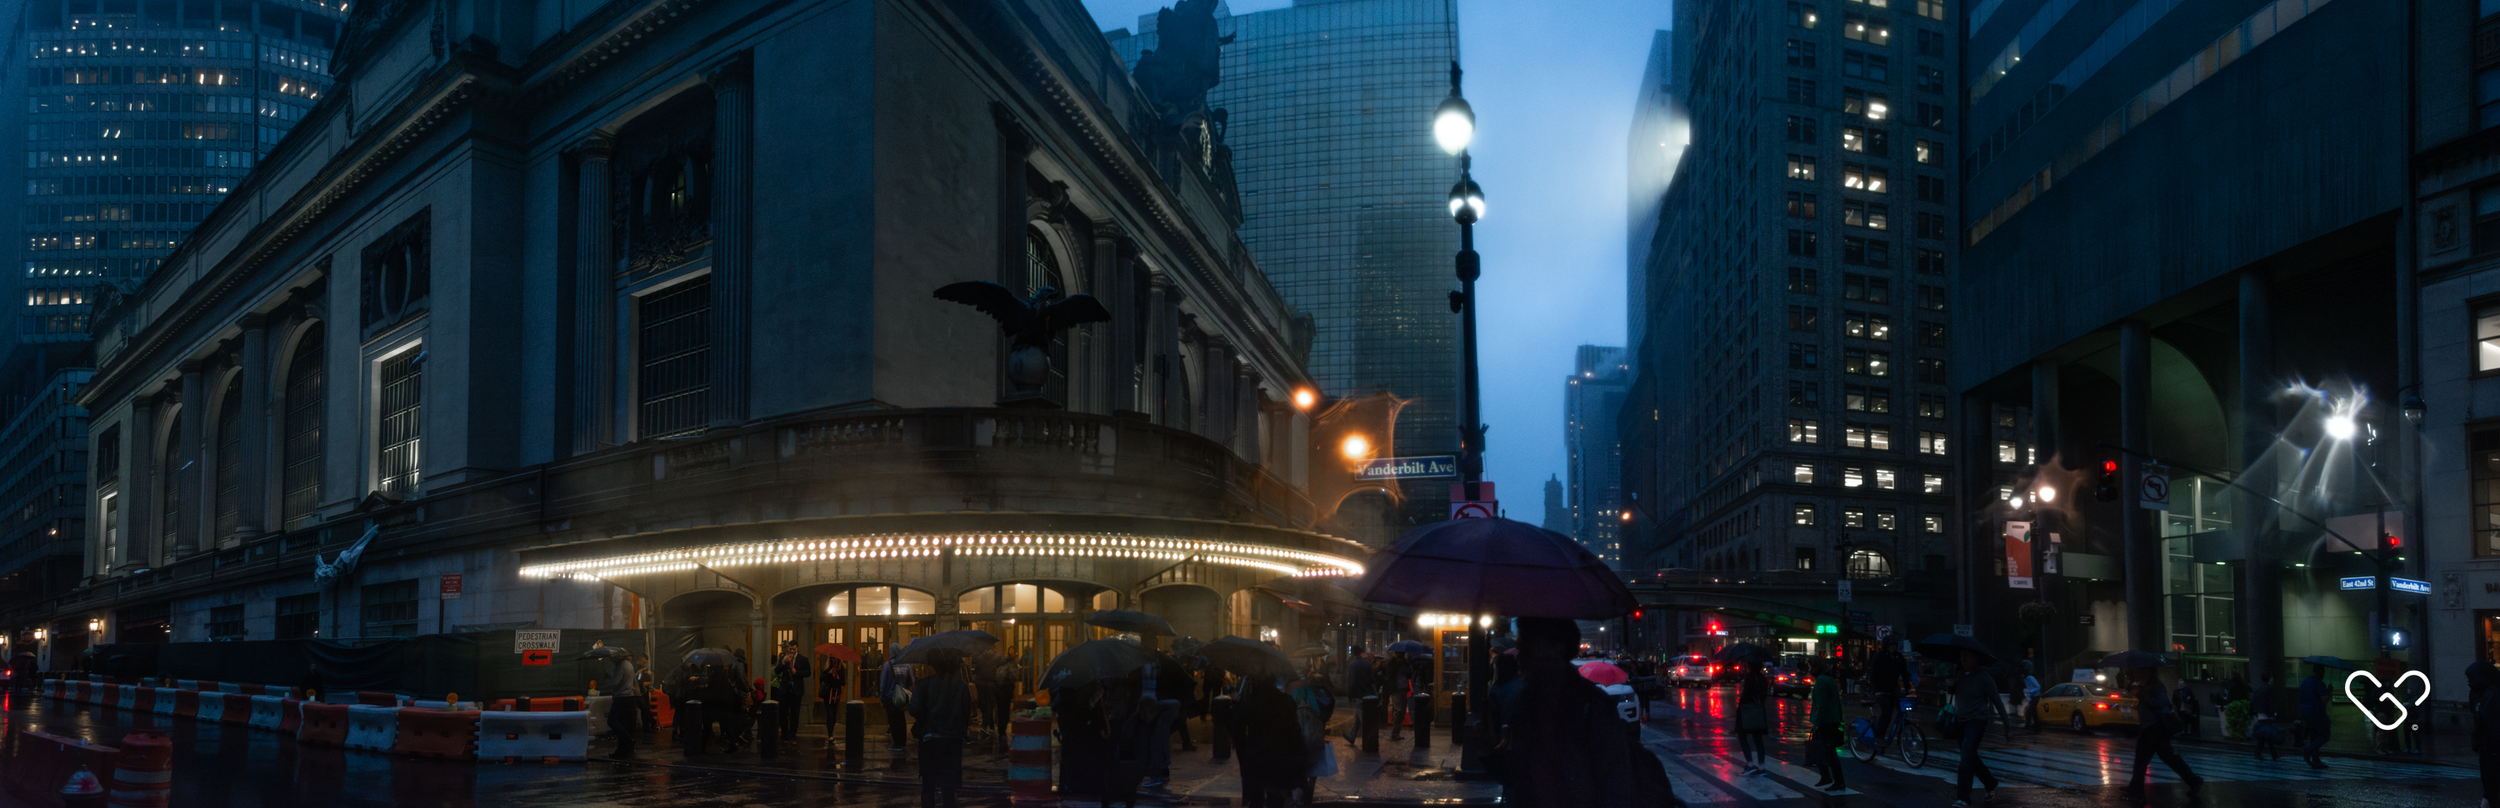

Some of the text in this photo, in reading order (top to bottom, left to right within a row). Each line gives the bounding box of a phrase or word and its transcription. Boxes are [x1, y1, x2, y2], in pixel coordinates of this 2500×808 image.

[1357, 460, 1453, 476] Vanderbilt Ave
[2354, 579, 2367, 587] 42nd
[2391, 580, 2430, 592] Vanderbilt Ave
[518, 632, 557, 641] PEDESTRIAN
[518, 641, 556, 650] CROSSWALK
